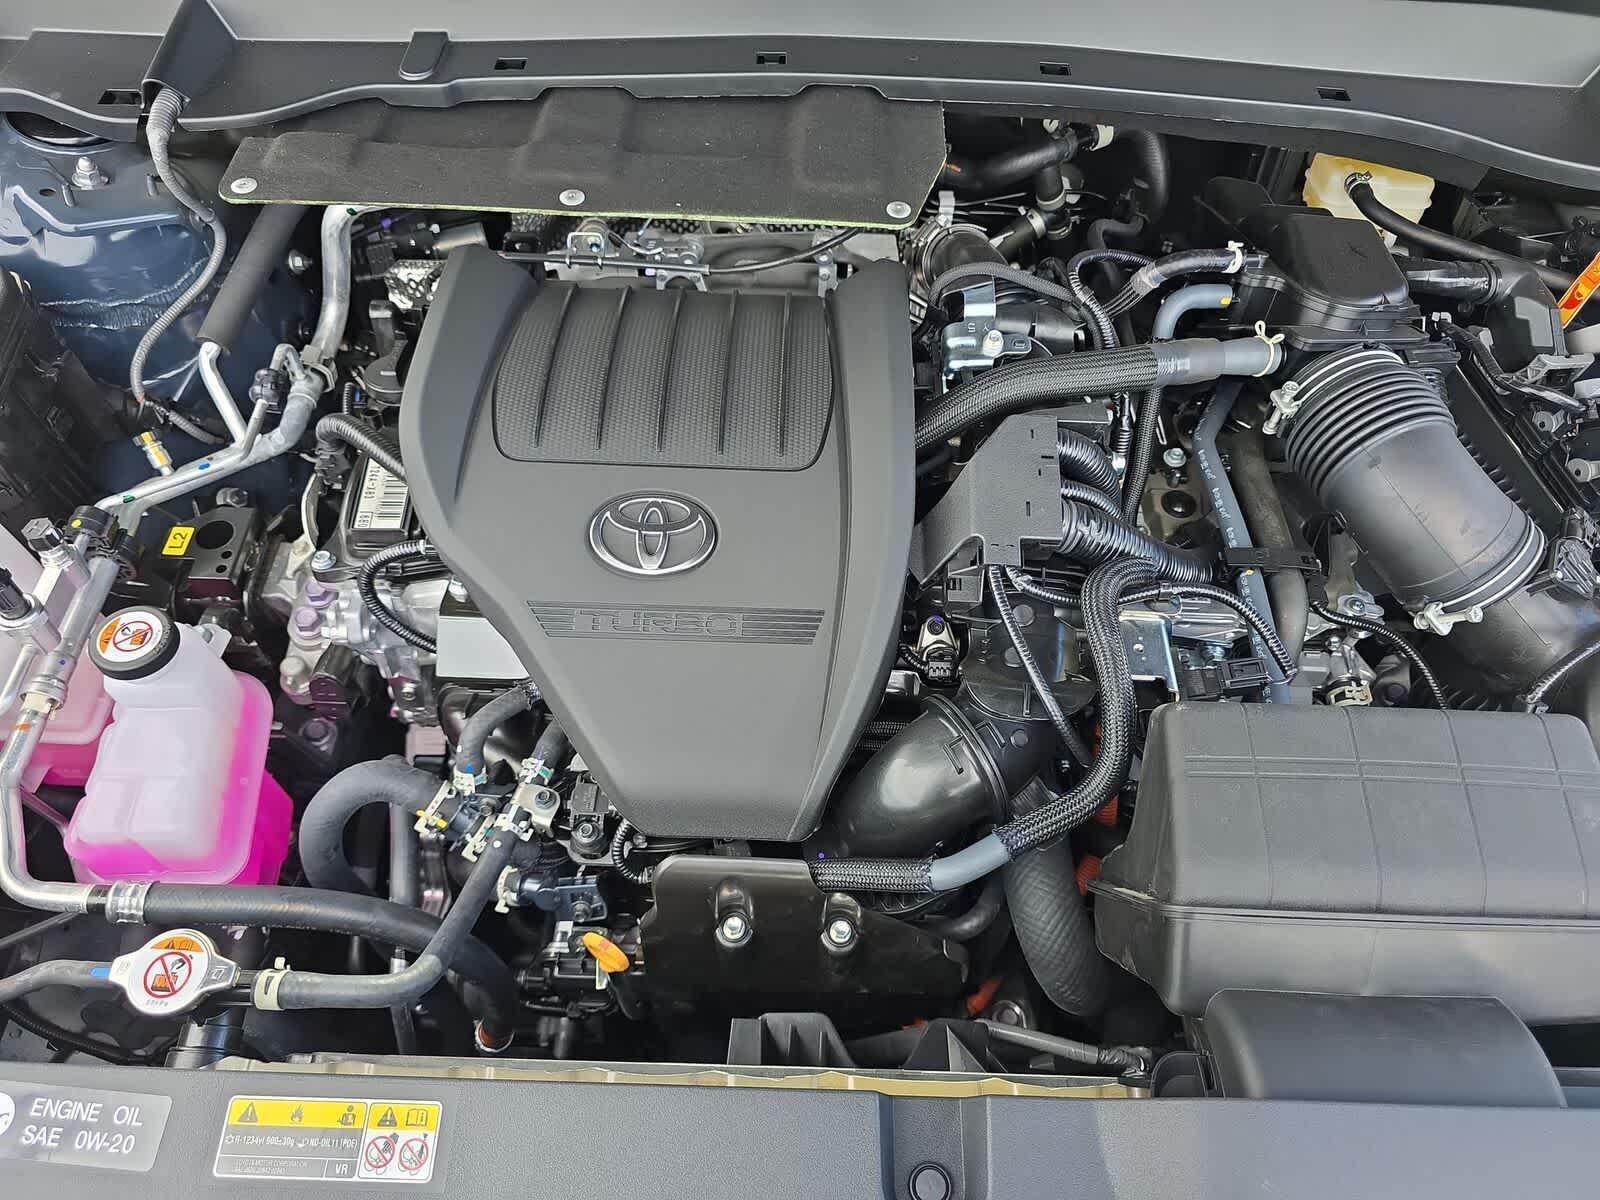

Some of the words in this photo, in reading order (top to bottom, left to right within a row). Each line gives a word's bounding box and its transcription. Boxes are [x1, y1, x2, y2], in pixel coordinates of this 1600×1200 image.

[167, 532, 188, 549] L2
[576, 608, 740, 638] TURBO
[30, 1097, 103, 1122] ENGINE
[113, 1105, 144, 1127] OIL
[21, 1124, 63, 1147] SAE
[74, 1130, 136, 1154] 0W-20
[335, 1163, 349, 1175] VR
